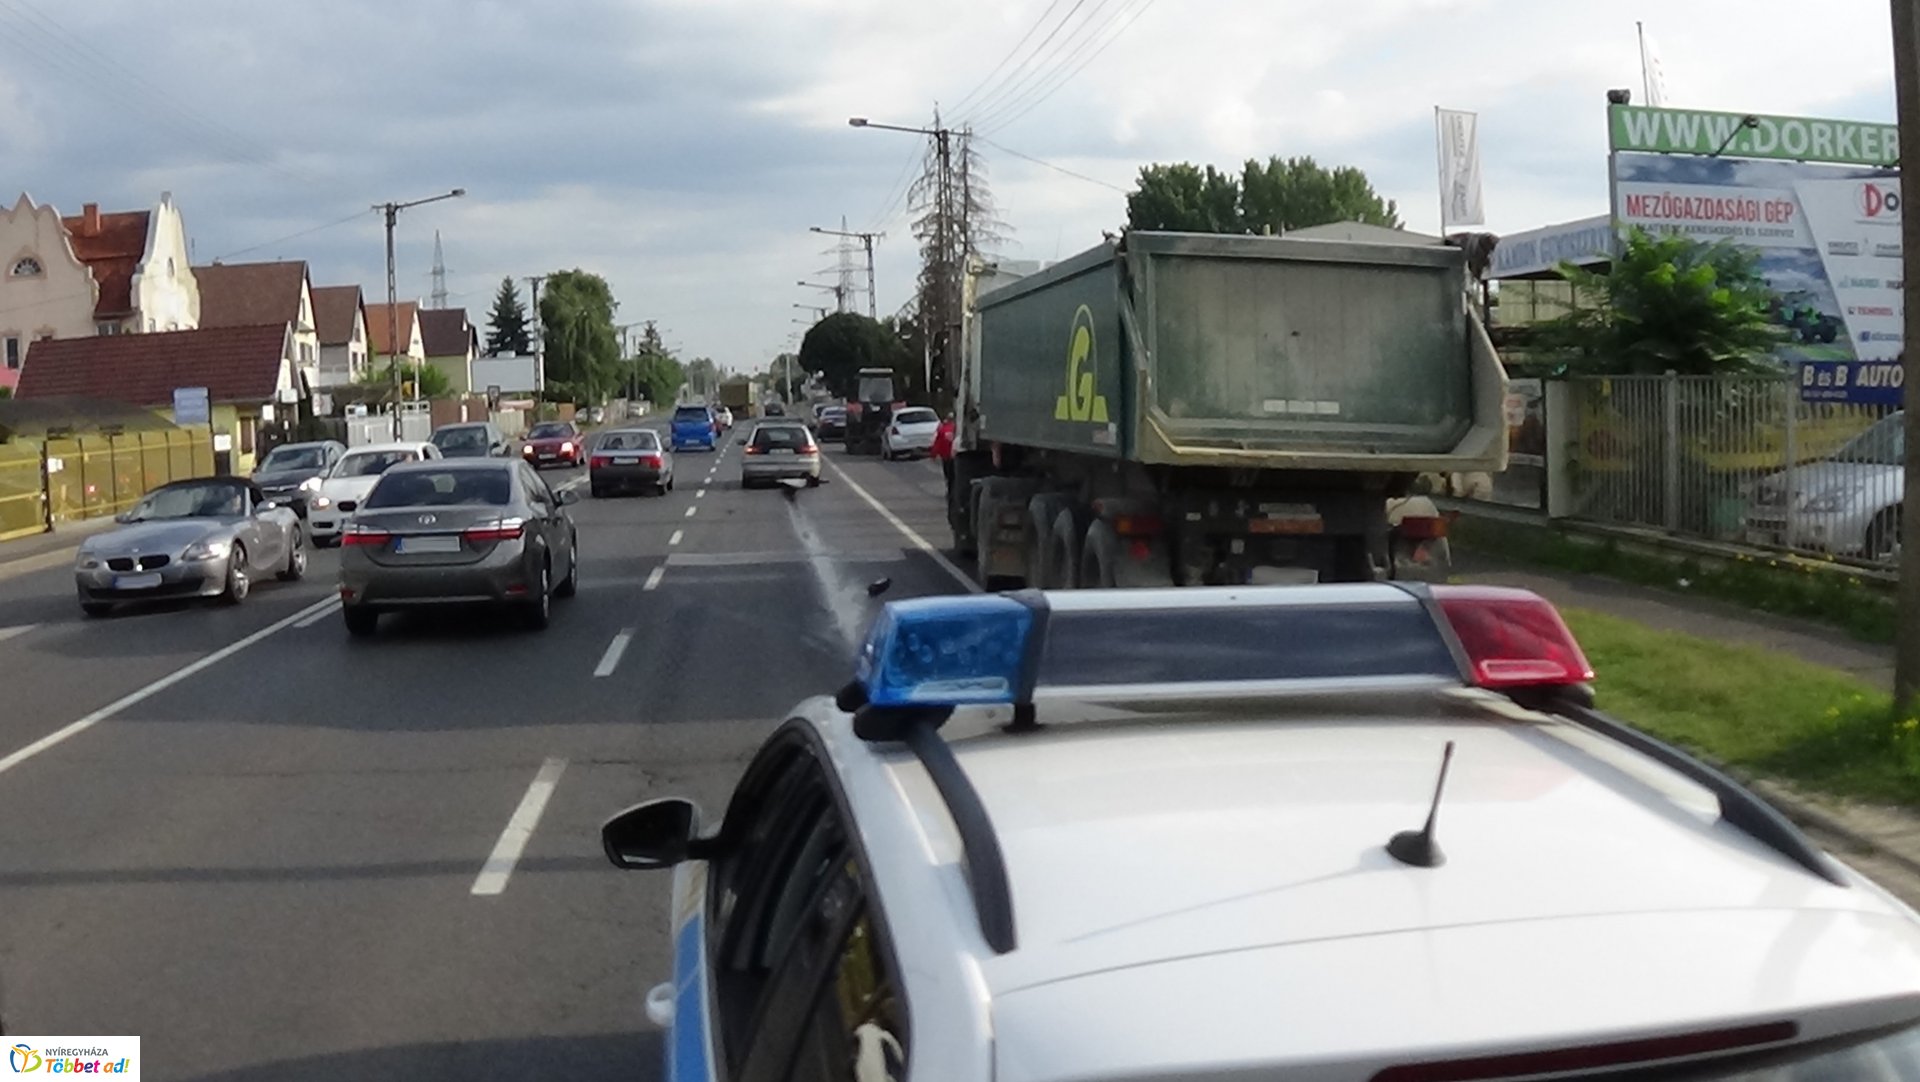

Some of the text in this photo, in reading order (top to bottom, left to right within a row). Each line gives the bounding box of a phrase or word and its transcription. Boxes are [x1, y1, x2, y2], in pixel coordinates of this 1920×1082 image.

[1626, 191, 1795, 223] MEZŐGAZDASÁGI GÉP
[1803, 365, 1815, 386] B
[1835, 365, 1848, 386] B
[1855, 364, 1904, 388] AUTO
